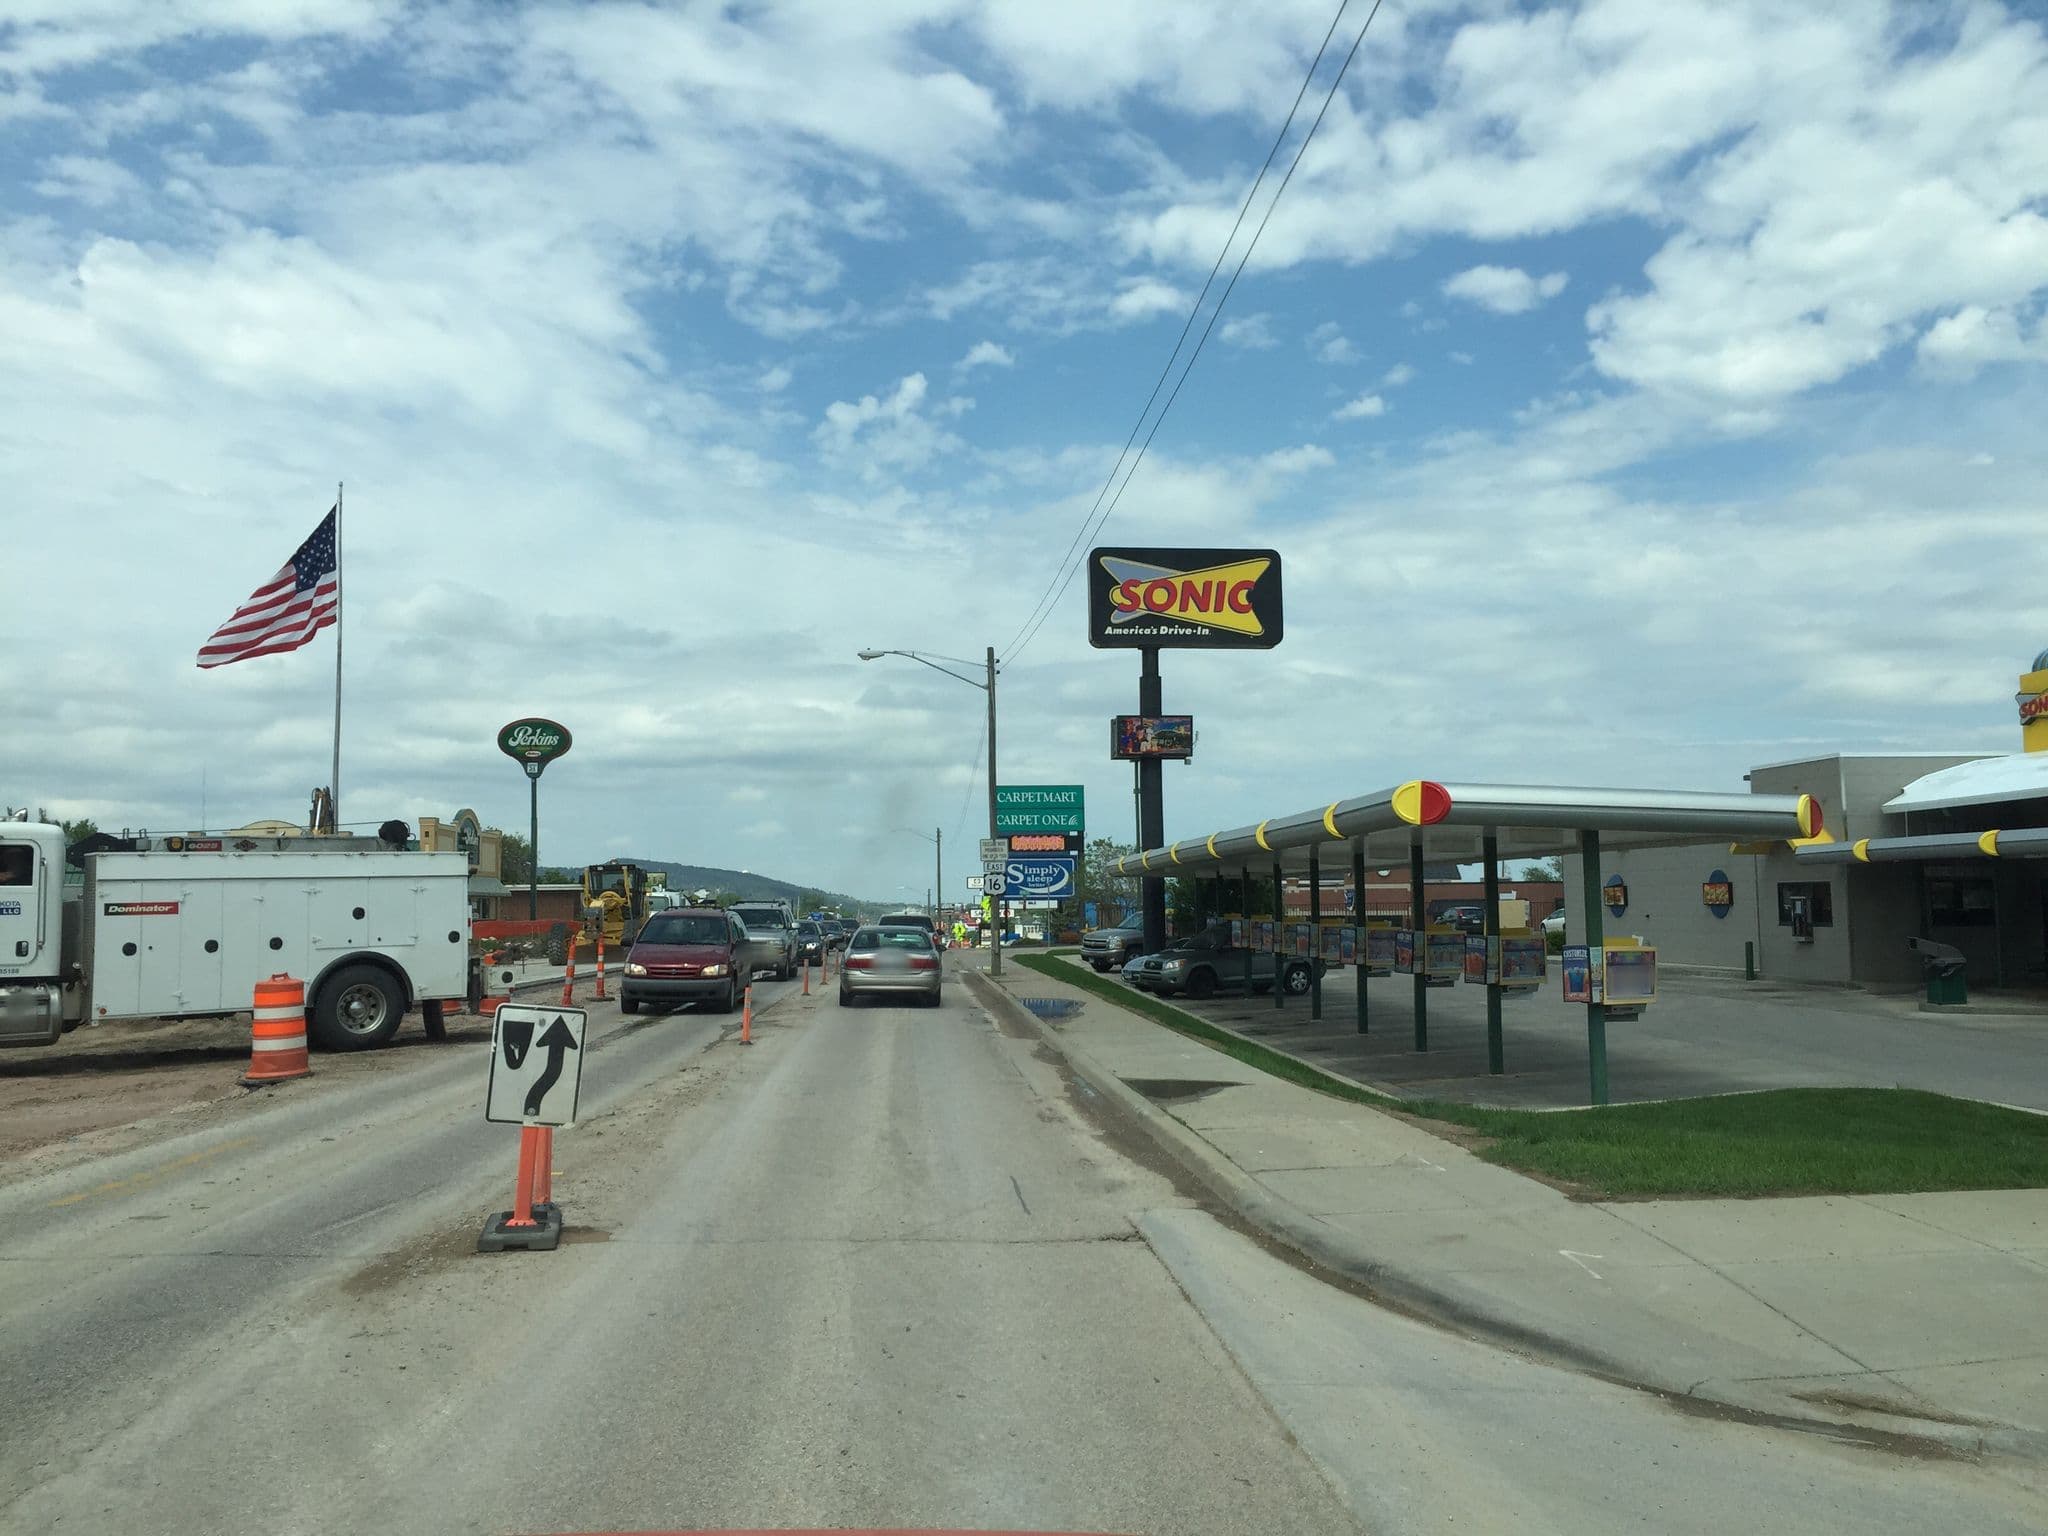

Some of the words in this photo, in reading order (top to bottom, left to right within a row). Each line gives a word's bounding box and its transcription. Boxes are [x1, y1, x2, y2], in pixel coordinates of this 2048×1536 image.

[1117, 578, 1256, 614] SONIC
[1104, 625, 1158, 636] America's
[508, 726, 559, 746] Perkins
[997, 791, 1076, 802] CARPETMART
[997, 814, 1040, 825] CARPET
[1042, 814, 1068, 826] ONE
[986, 862, 1004, 871] EAST
[1007, 863, 1060, 884] Simply
[988, 878, 1002, 891] 16
[108, 904, 173, 913] Dominator
